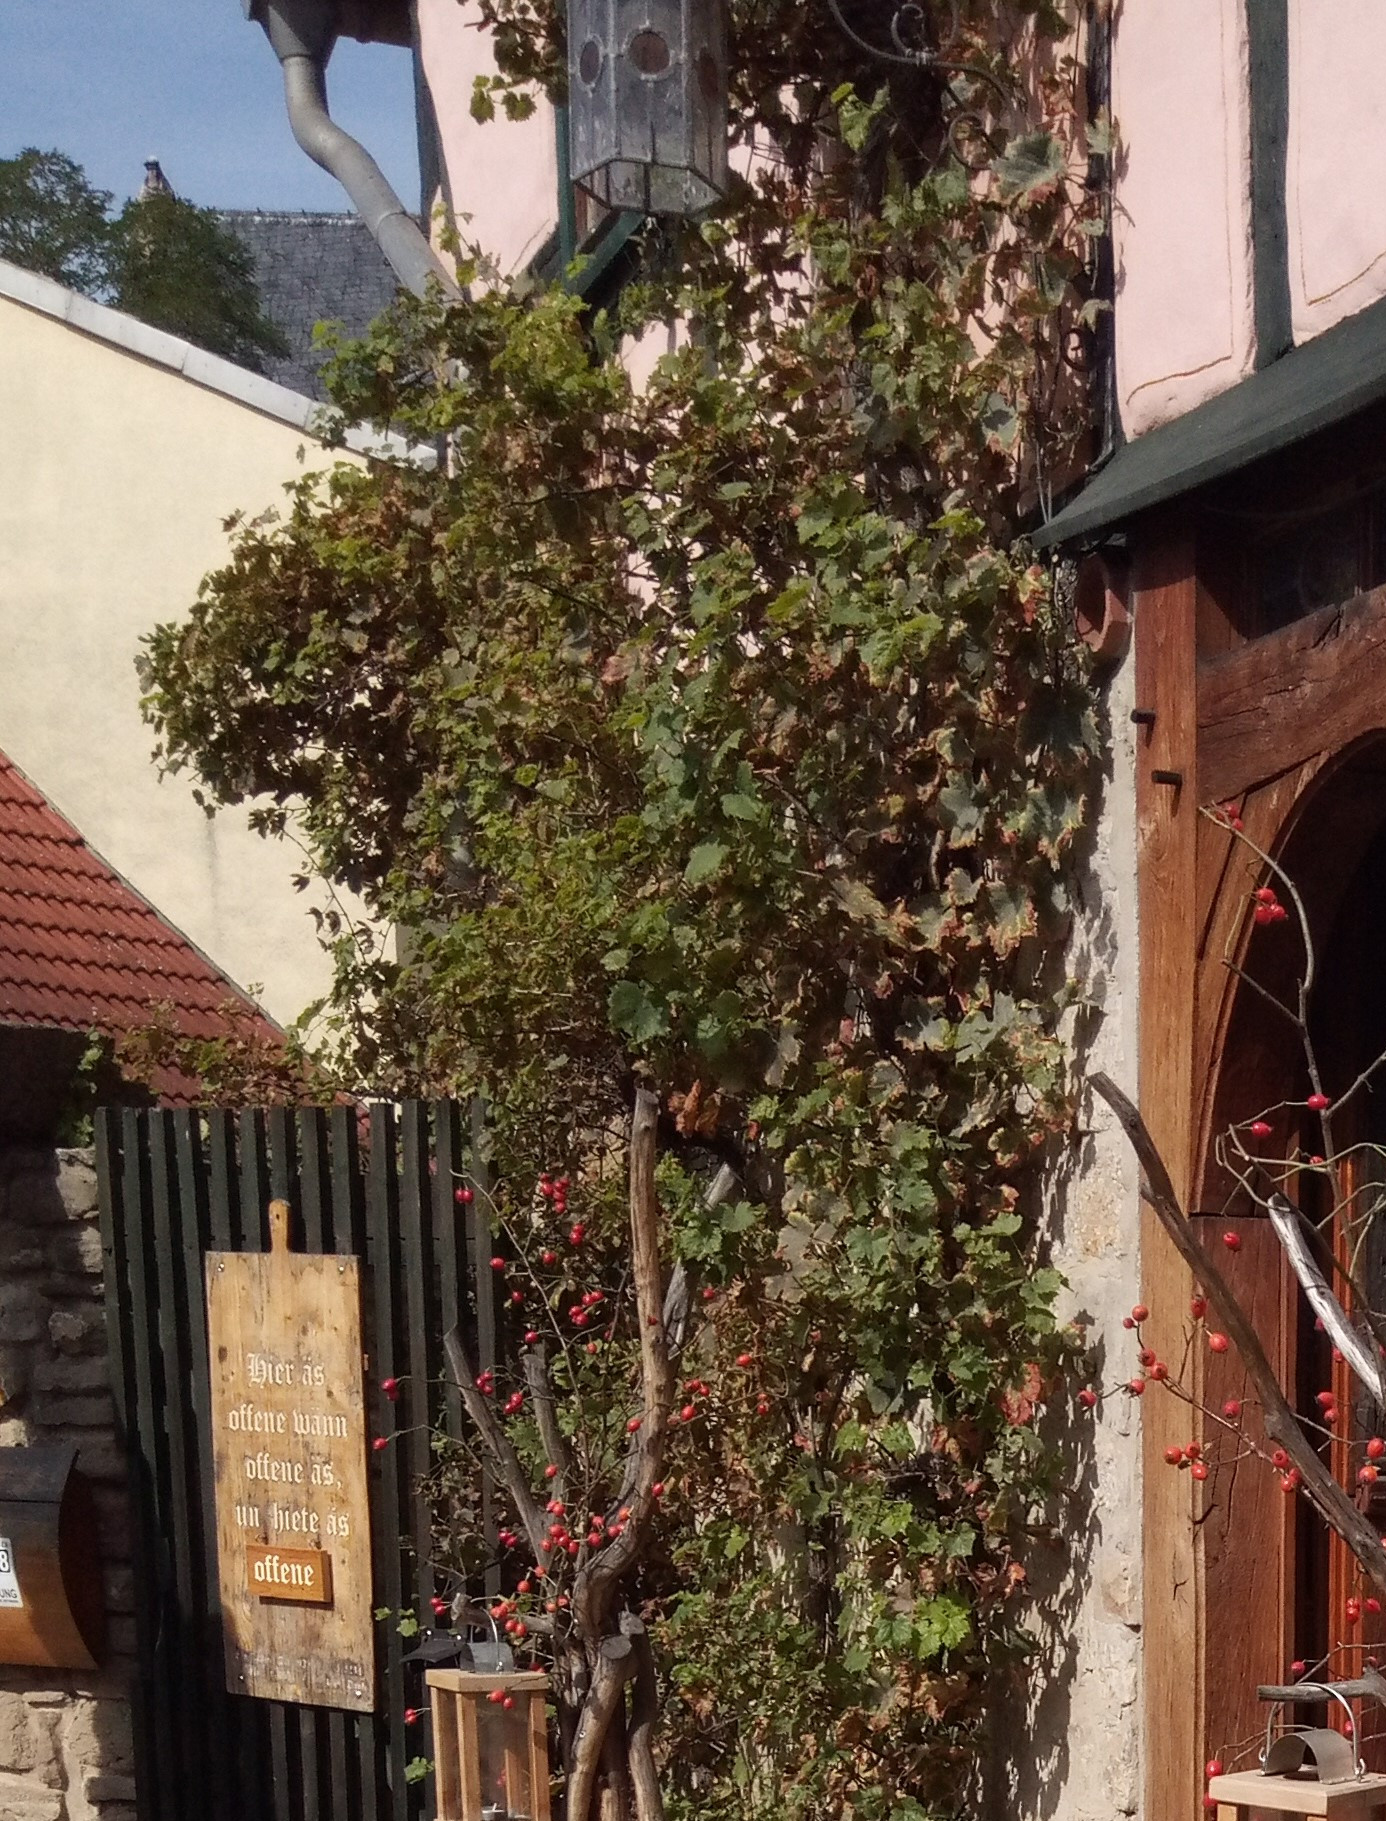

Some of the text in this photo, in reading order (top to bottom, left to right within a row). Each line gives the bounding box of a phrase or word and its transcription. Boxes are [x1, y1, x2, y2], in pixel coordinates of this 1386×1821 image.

[247, 1353, 325, 1388] Hier äs
[229, 1404, 347, 1437] offene wänn
[246, 1453, 303, 1483] offene
[236, 1505, 259, 1527] un
[326, 1507, 350, 1536] äs
[254, 1555, 314, 1586] offene
